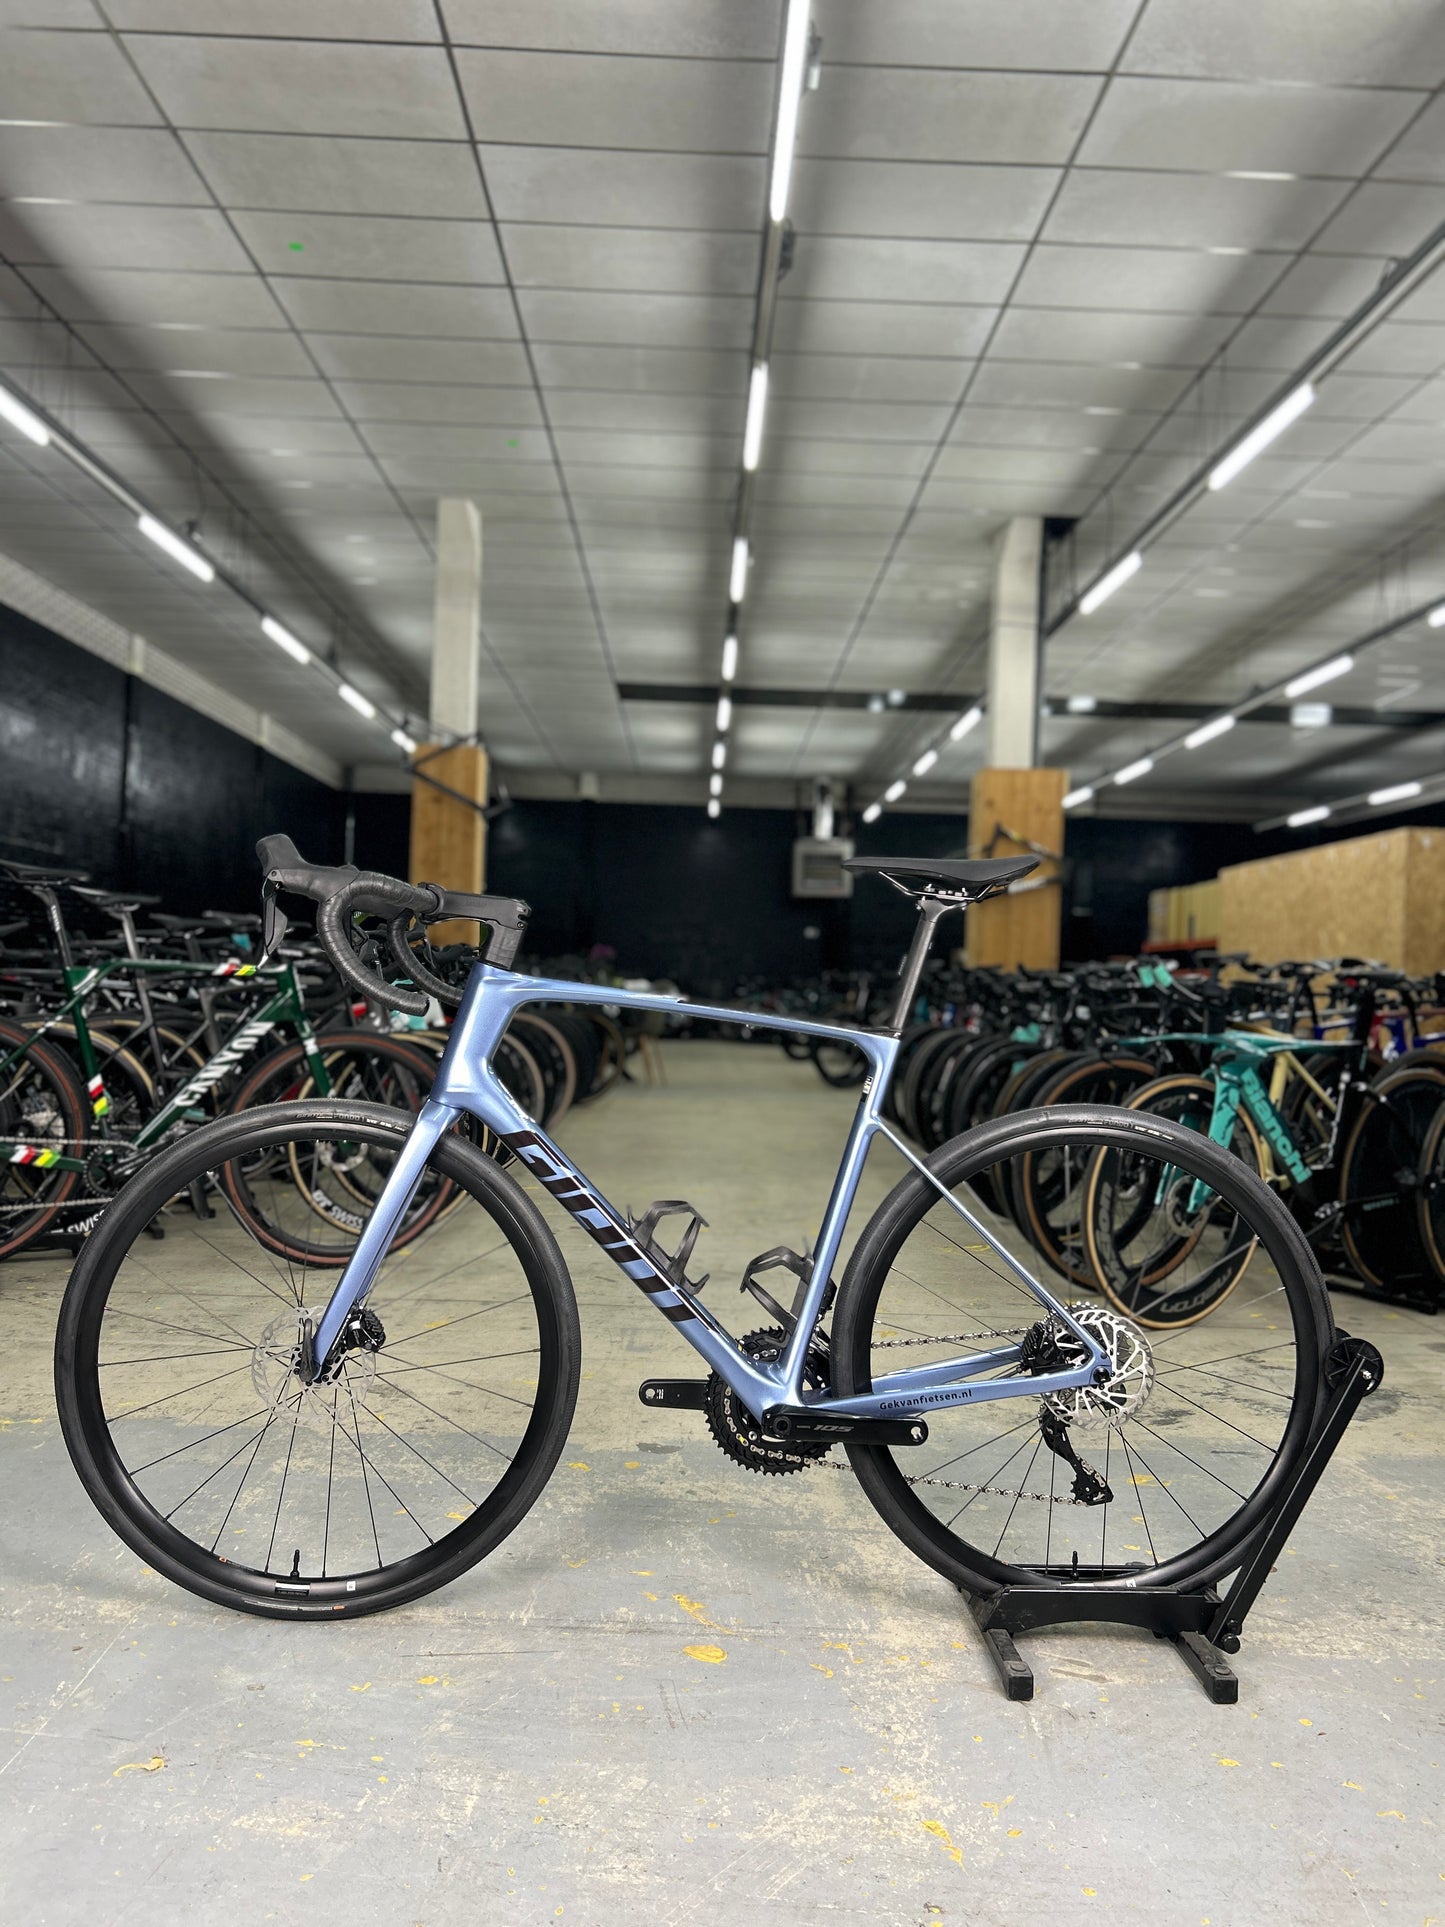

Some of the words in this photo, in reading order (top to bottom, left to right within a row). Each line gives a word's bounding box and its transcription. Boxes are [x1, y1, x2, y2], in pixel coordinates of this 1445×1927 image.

[173, 1021, 276, 1107] CANYON
[1240, 1066, 1313, 1184] Bianchi
[312, 1189, 333, 1208] DT
[329, 1205, 364, 1229] SWISS
[500, 1130, 717, 1332] GIANT
[813, 1424, 854, 1433] 105
[879, 1389, 972, 1410] Gekvanfietsen.nl
